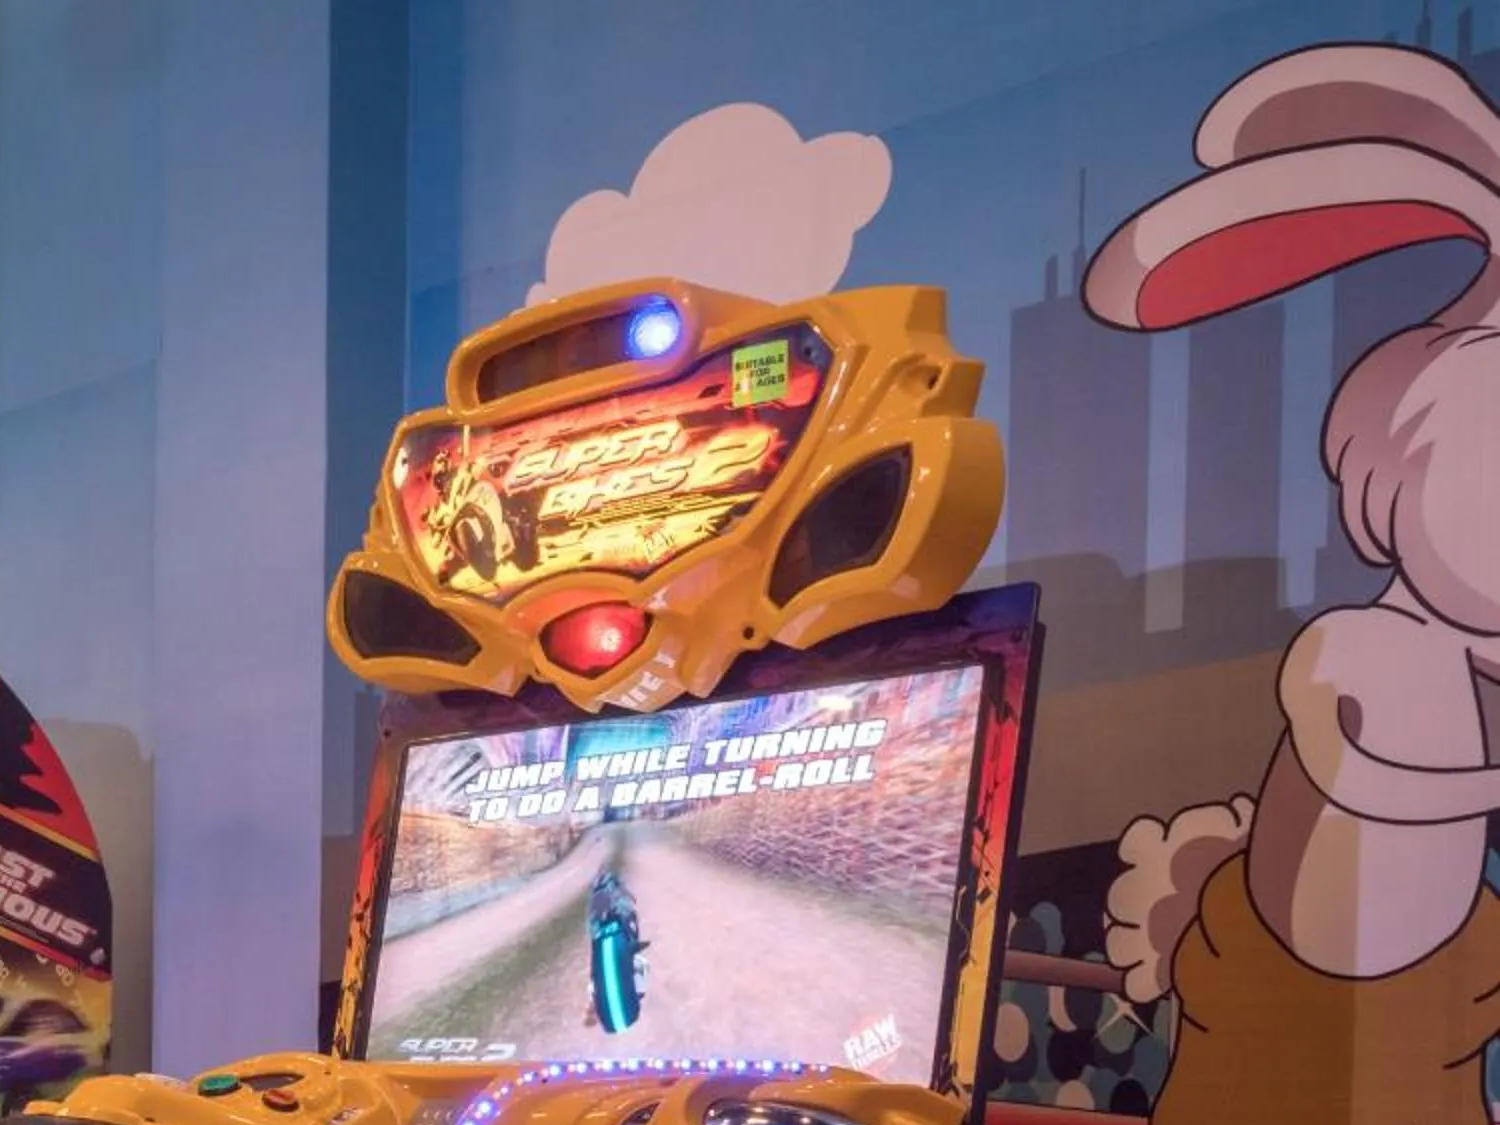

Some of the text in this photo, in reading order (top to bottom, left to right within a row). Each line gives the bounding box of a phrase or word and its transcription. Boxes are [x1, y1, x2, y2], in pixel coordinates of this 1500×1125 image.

[503, 420, 683, 495] SUPER
[537, 424, 775, 520] BIKES 2
[466, 719, 888, 795] JUMP WHILE TURNING
[467, 754, 874, 825] TO DO A BARREL-ROLL
[843, 1013, 897, 1062] RAW
